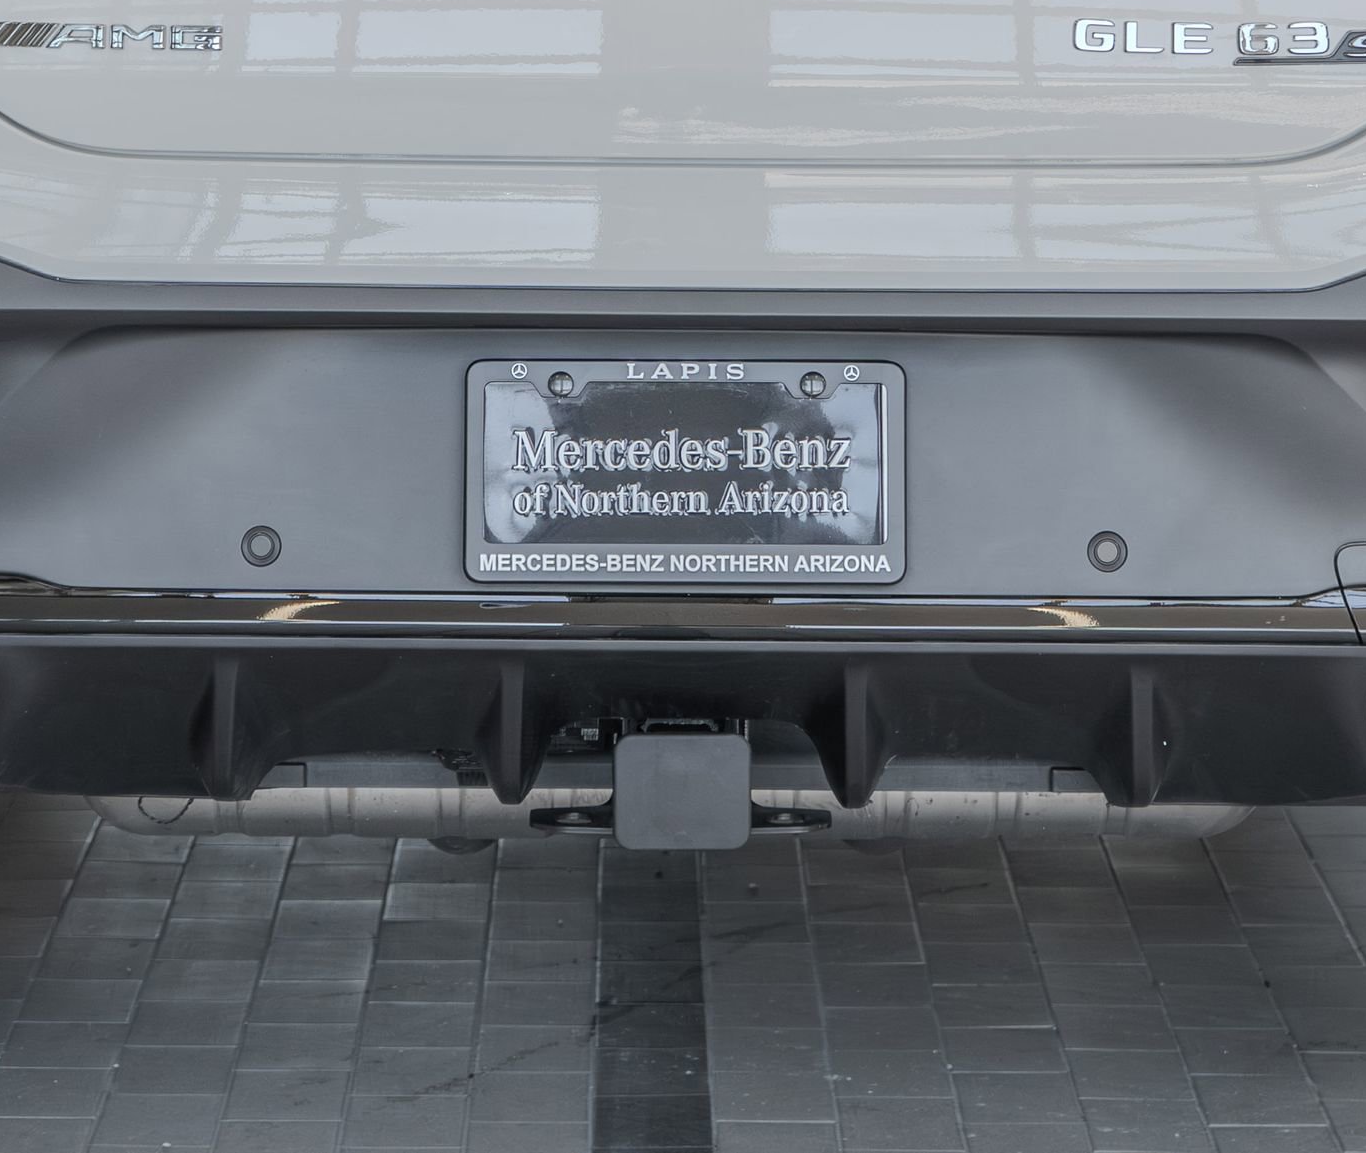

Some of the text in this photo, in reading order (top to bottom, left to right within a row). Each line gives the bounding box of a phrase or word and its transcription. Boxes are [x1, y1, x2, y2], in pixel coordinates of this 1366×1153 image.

[46, 22, 223, 51] AMG
[1073, 18, 1214, 55] GLE
[1236, 21, 1331, 56] 63
[626, 362, 745, 380] LAPIS
[512, 428, 851, 472] Mercedes-Benz
[513, 481, 850, 516] of Northern Arizona
[479, 553, 892, 574] MERCEDES-BENZ NORTHERN ARIZONA
